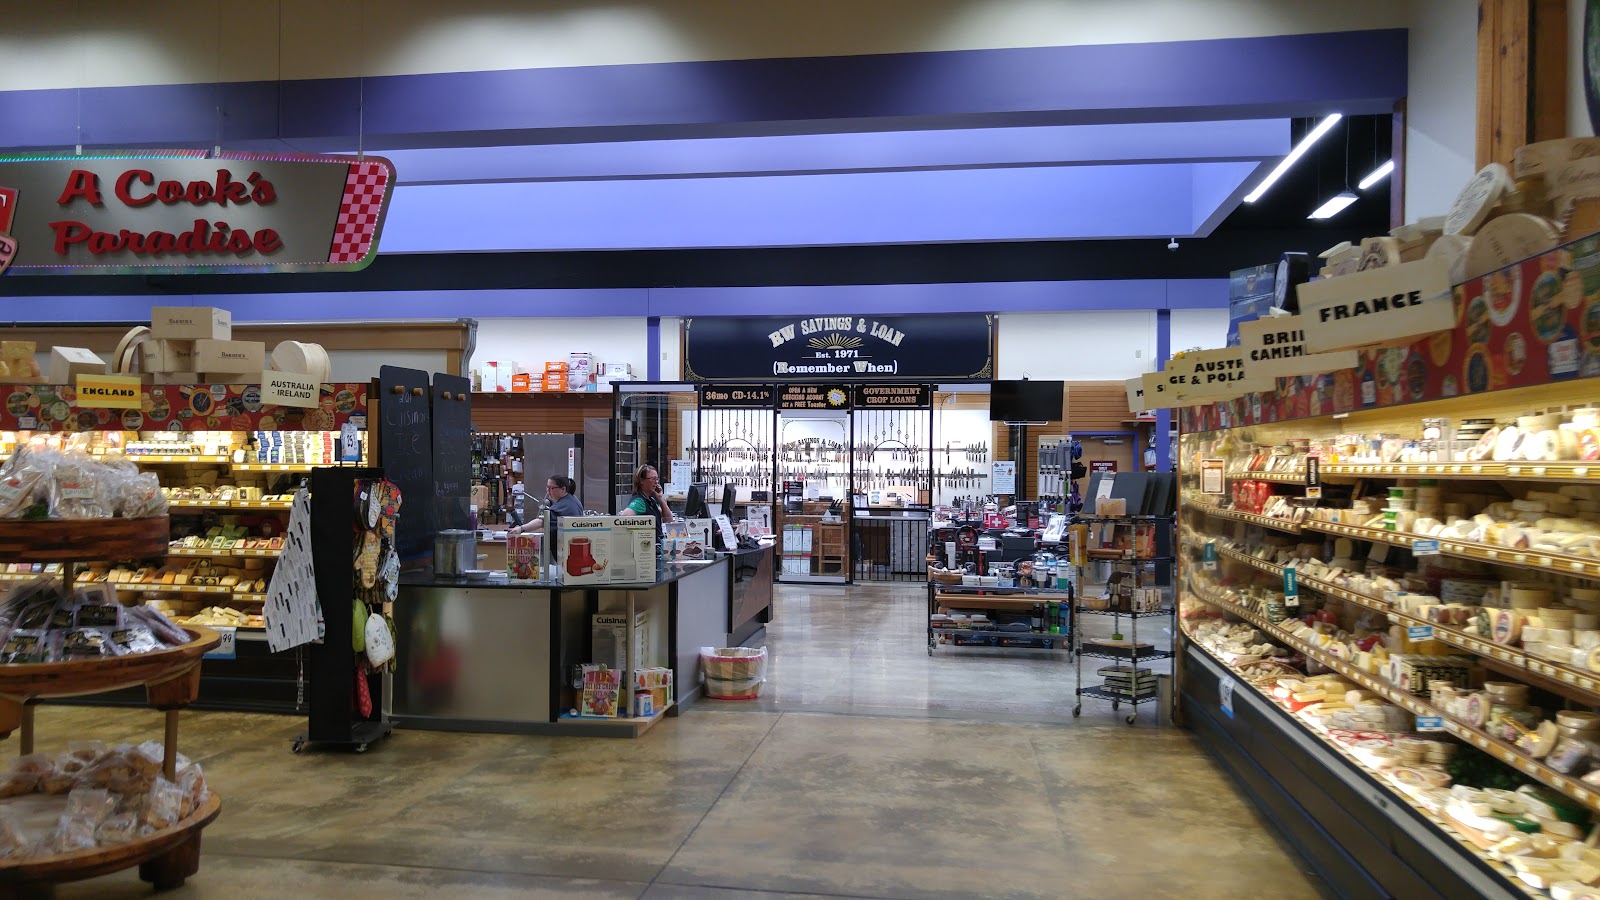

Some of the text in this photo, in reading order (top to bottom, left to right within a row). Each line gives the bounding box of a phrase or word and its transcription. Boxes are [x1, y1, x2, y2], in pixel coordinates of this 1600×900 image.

[56, 168, 278, 207] A Cook's
[48, 218, 284, 256] Paradise
[1319, 289, 1422, 323] FRANCE
[768, 316, 906, 348] BW SAVINGS & LOAN
[815, 350, 859, 359] Est. 1971
[1251, 344, 1307, 361] CAMEM
[773, 360, 898, 375] (Remember When)
[1169, 375, 1186, 385] GE
[270, 380, 315, 391] AUSTRALIA
[1157, 384, 1166, 392] S
[82, 387, 135, 397] ENGLAND
[276, 389, 311, 399] IRELAND
[705, 391, 770, 400] 36mo CD-14.1%
[863, 387, 921, 395] GOVERNMENT
[866, 396, 917, 404] CROP LOANS
[614, 518, 652, 526] Cuisinart
